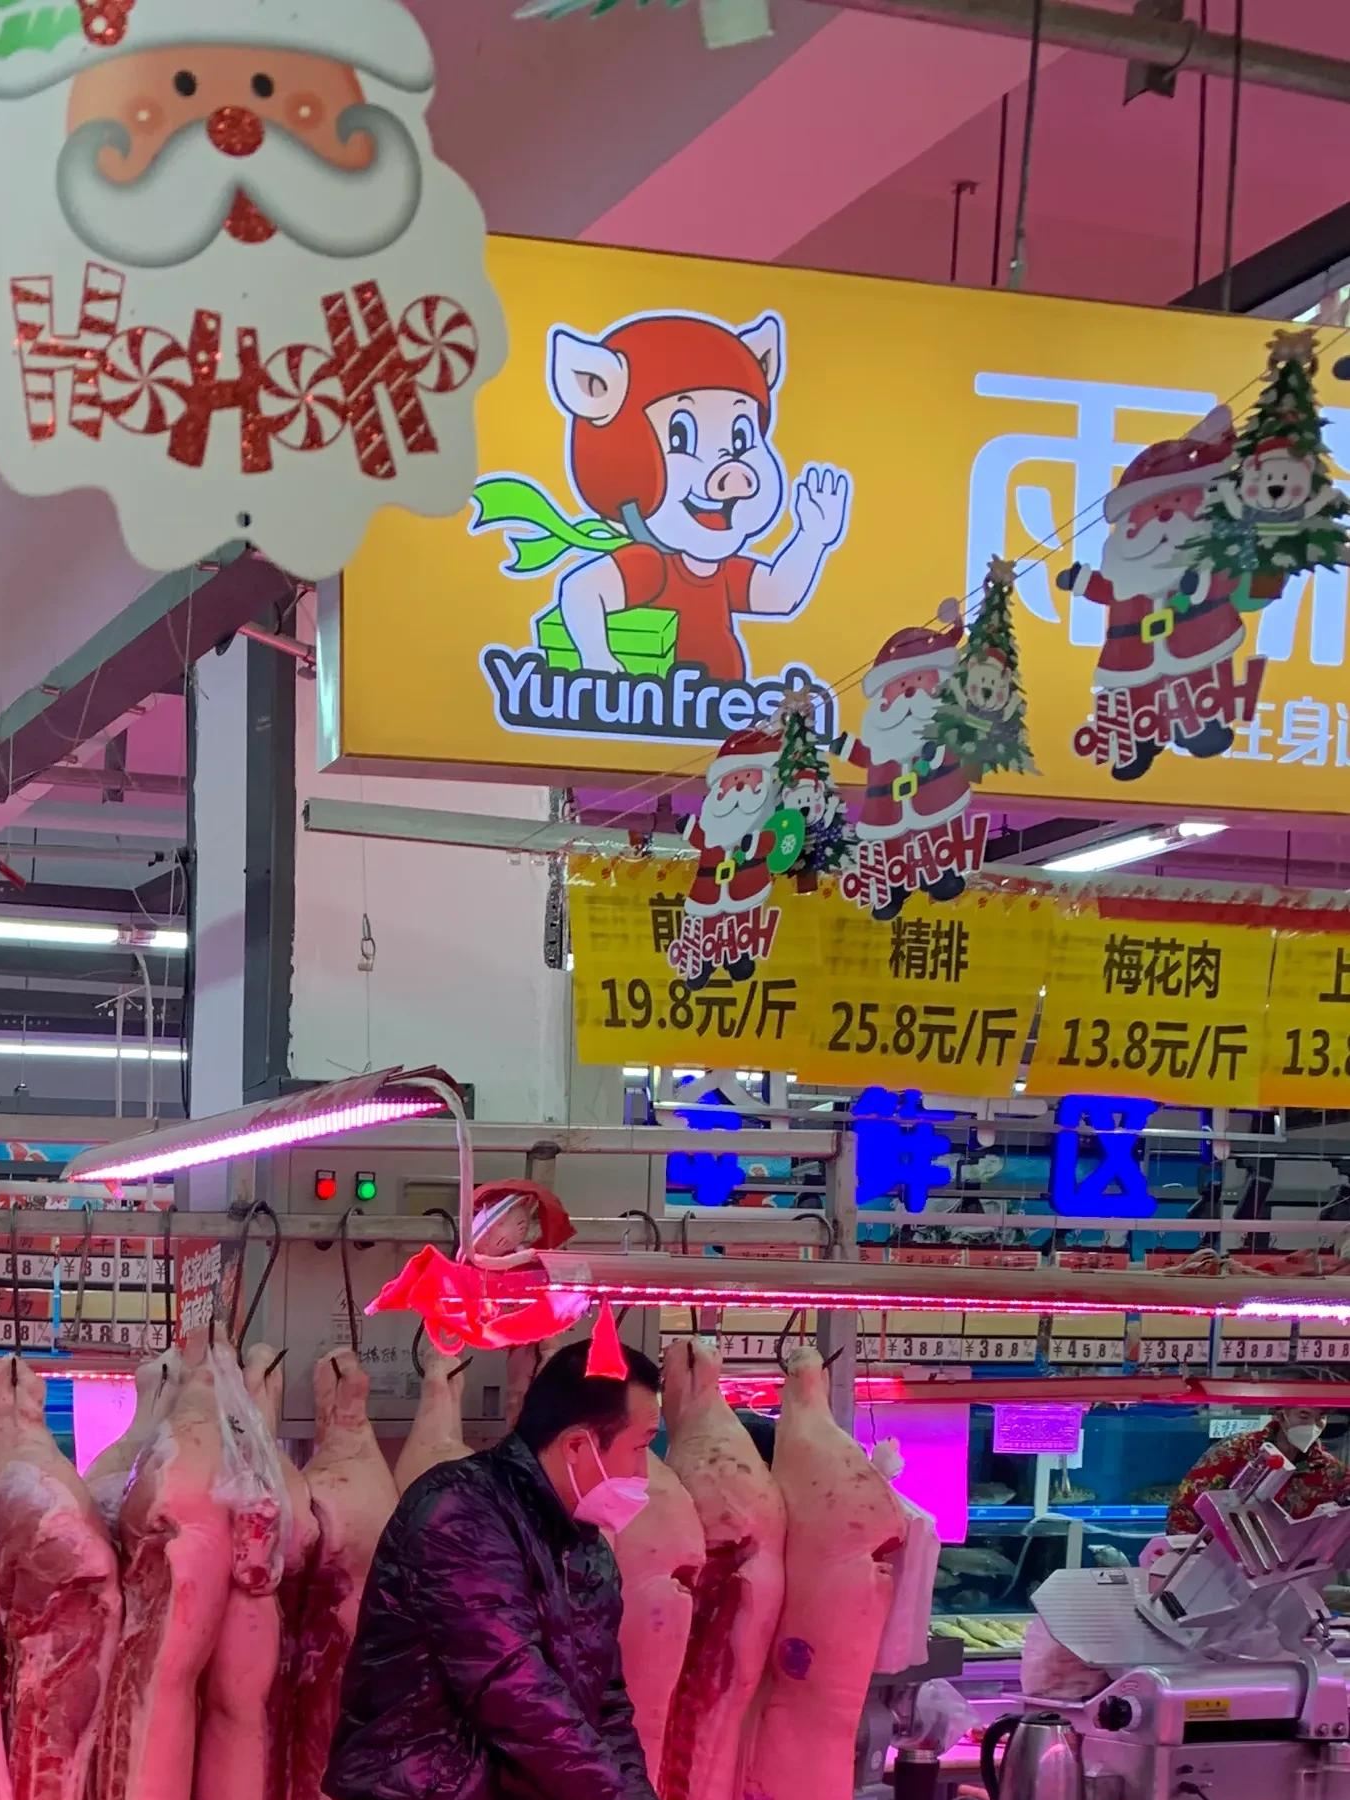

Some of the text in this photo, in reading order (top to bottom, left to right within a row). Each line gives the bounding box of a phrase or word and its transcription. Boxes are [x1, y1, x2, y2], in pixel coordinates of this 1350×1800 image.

[889, 915, 970, 983] 精排
[1104, 933, 1221, 1000] 梅花肉
[601, 978, 797, 1040] 19.8元/斤
[828, 1001, 1018, 1066] 25.8元/斤
[1057, 1018, 1247, 1081] 13.8元/斤
